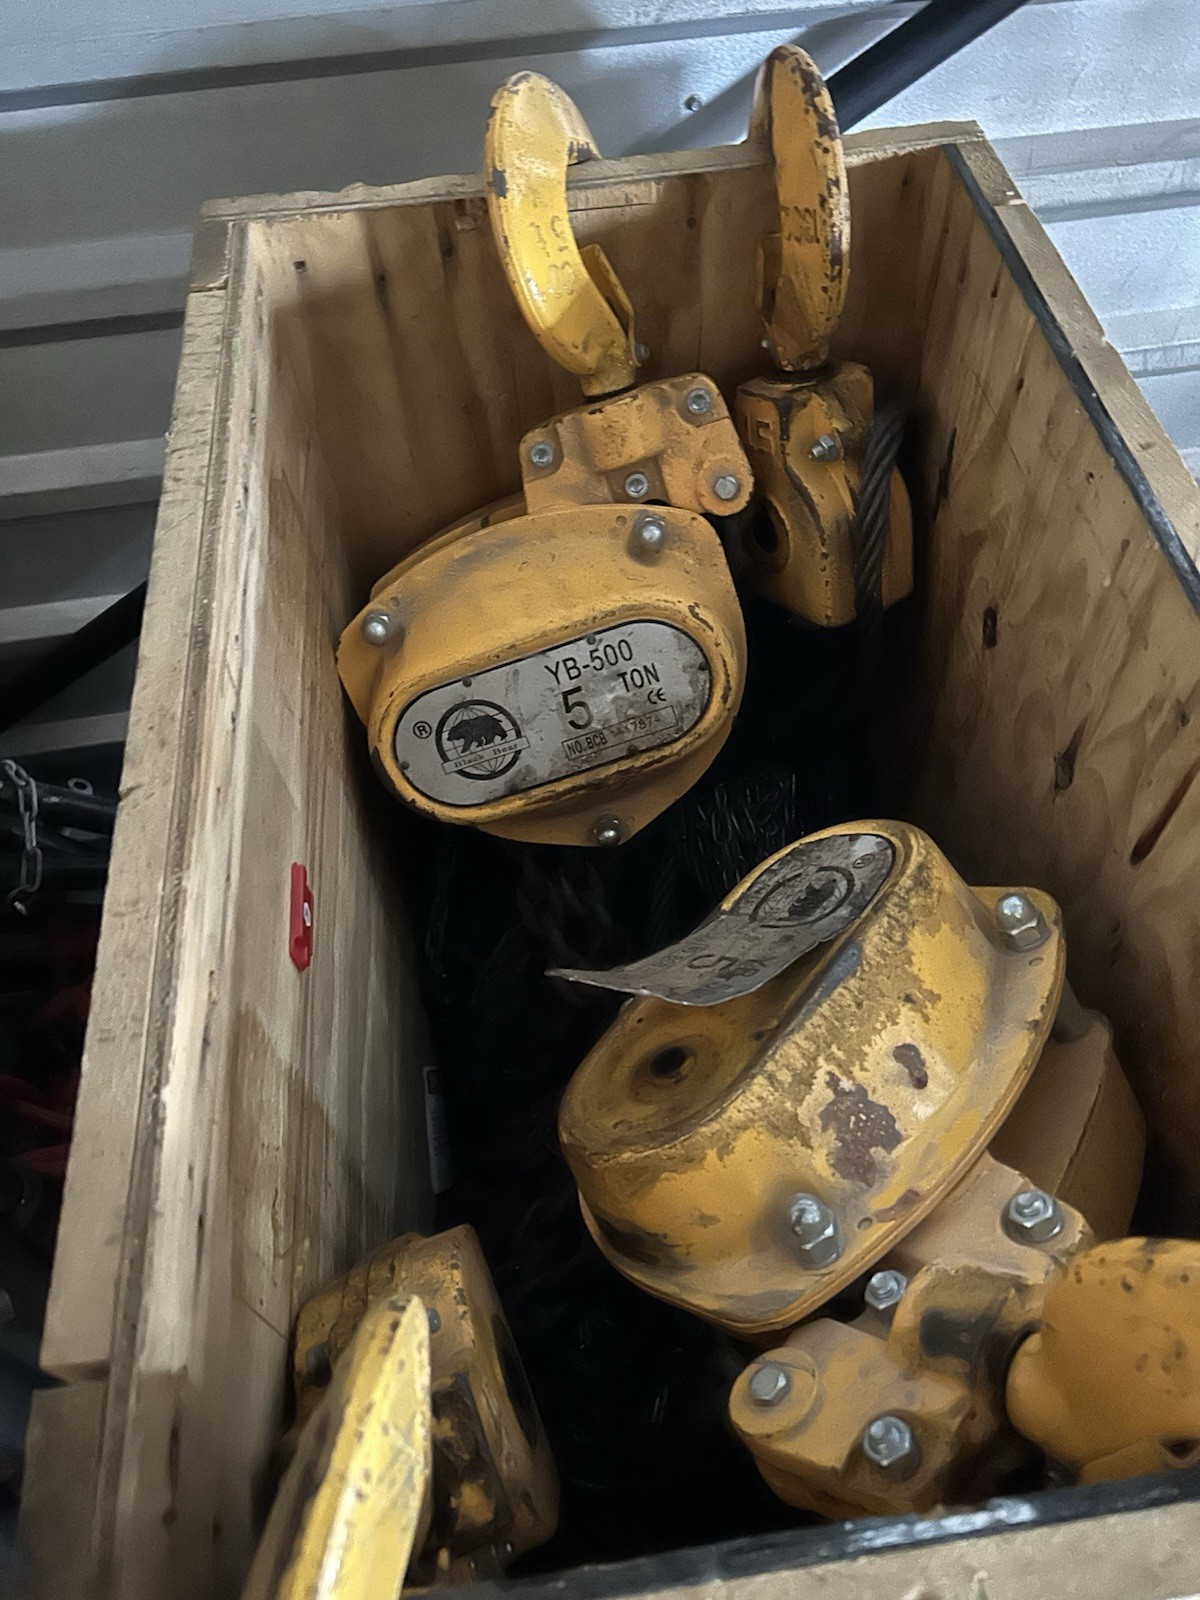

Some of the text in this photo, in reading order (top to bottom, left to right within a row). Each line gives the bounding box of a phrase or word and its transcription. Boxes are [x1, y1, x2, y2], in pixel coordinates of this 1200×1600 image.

[544, 639, 633, 685] YB-500
[562, 662, 660, 729] 5 TON
[454, 744, 518, 768] Black Bear
